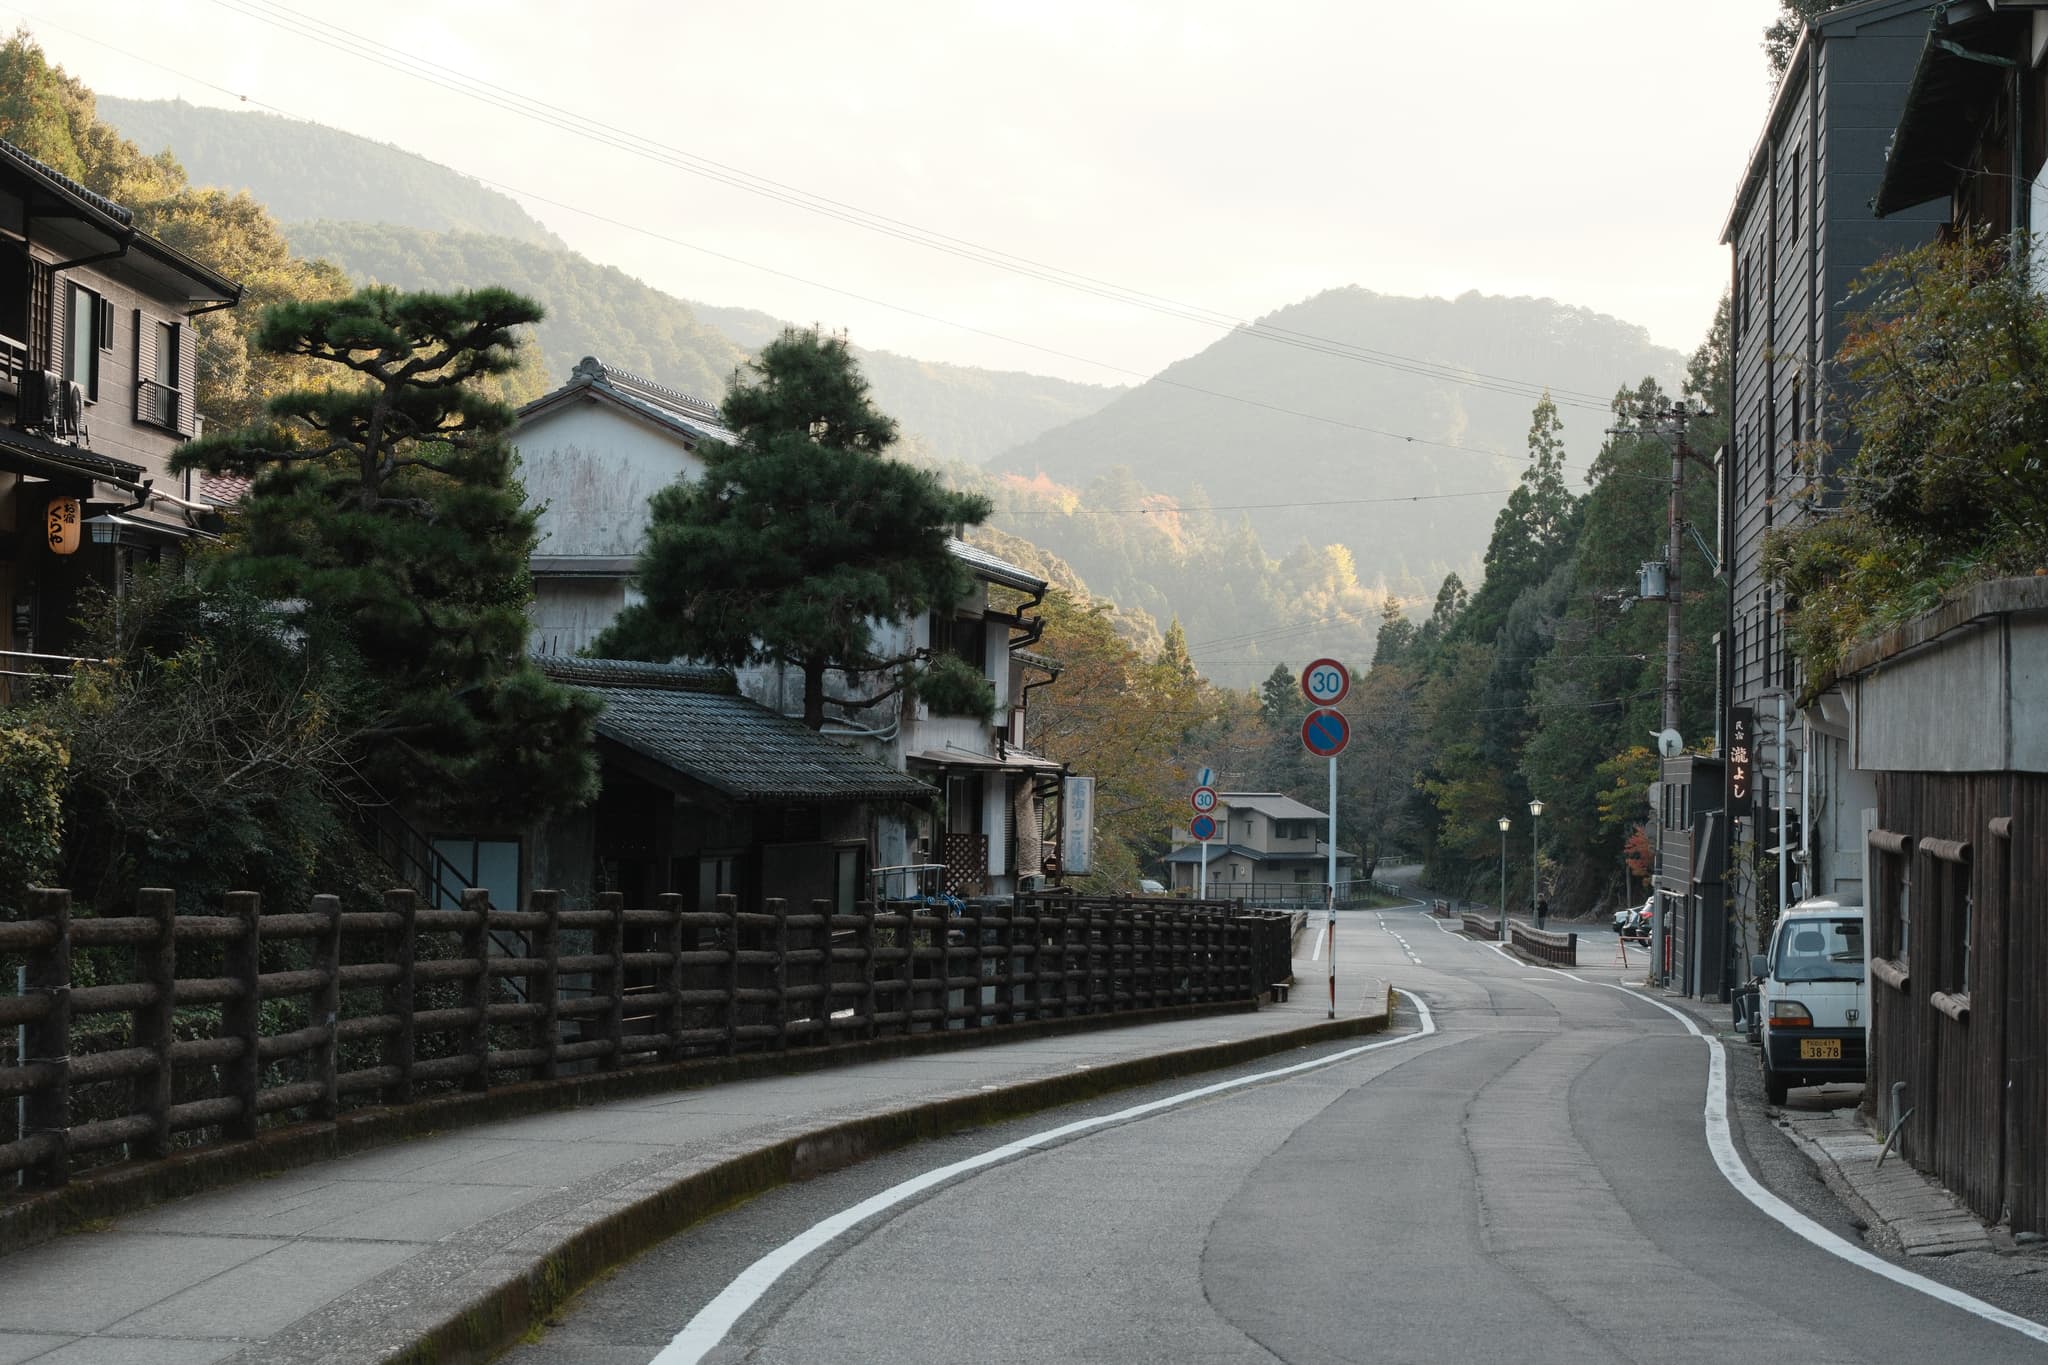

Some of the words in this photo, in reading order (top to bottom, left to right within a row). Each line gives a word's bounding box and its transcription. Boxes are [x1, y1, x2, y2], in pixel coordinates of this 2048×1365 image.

[64, 503, 75, 524] お宿
[1313, 672, 1339, 693] 30
[1734, 720, 1745, 740] 民宿
[1197, 794, 1212, 806] 30
[1809, 1047, 1839, 1058] 38-78
